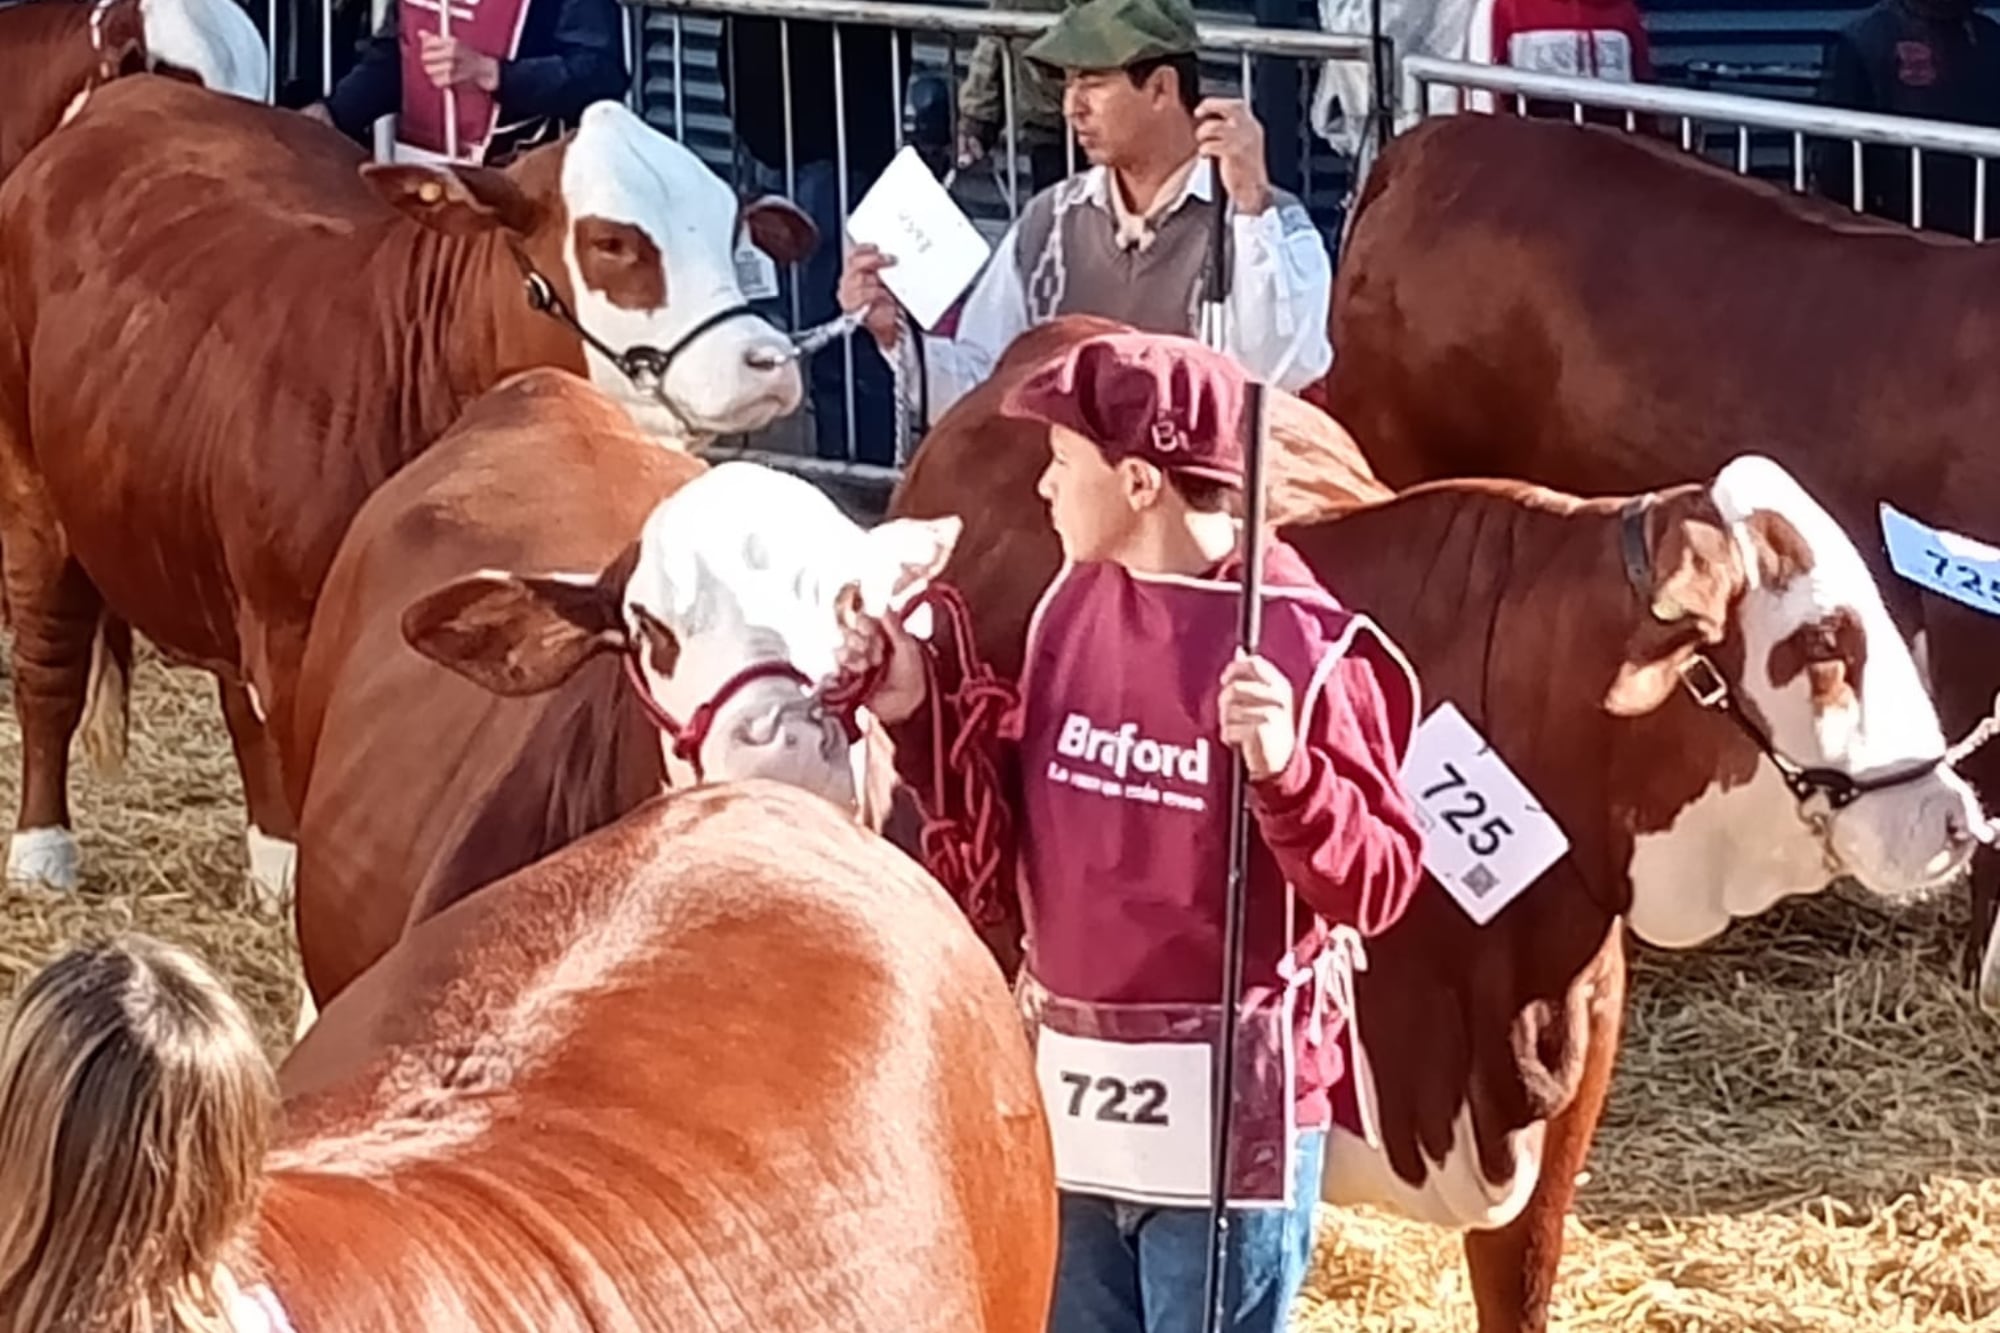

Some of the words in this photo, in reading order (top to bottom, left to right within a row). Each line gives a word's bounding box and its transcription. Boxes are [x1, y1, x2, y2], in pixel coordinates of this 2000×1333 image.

[1057, 713, 1209, 785] Braford
[1422, 762, 1514, 856] 725
[1060, 1070, 1169, 1126] 722
